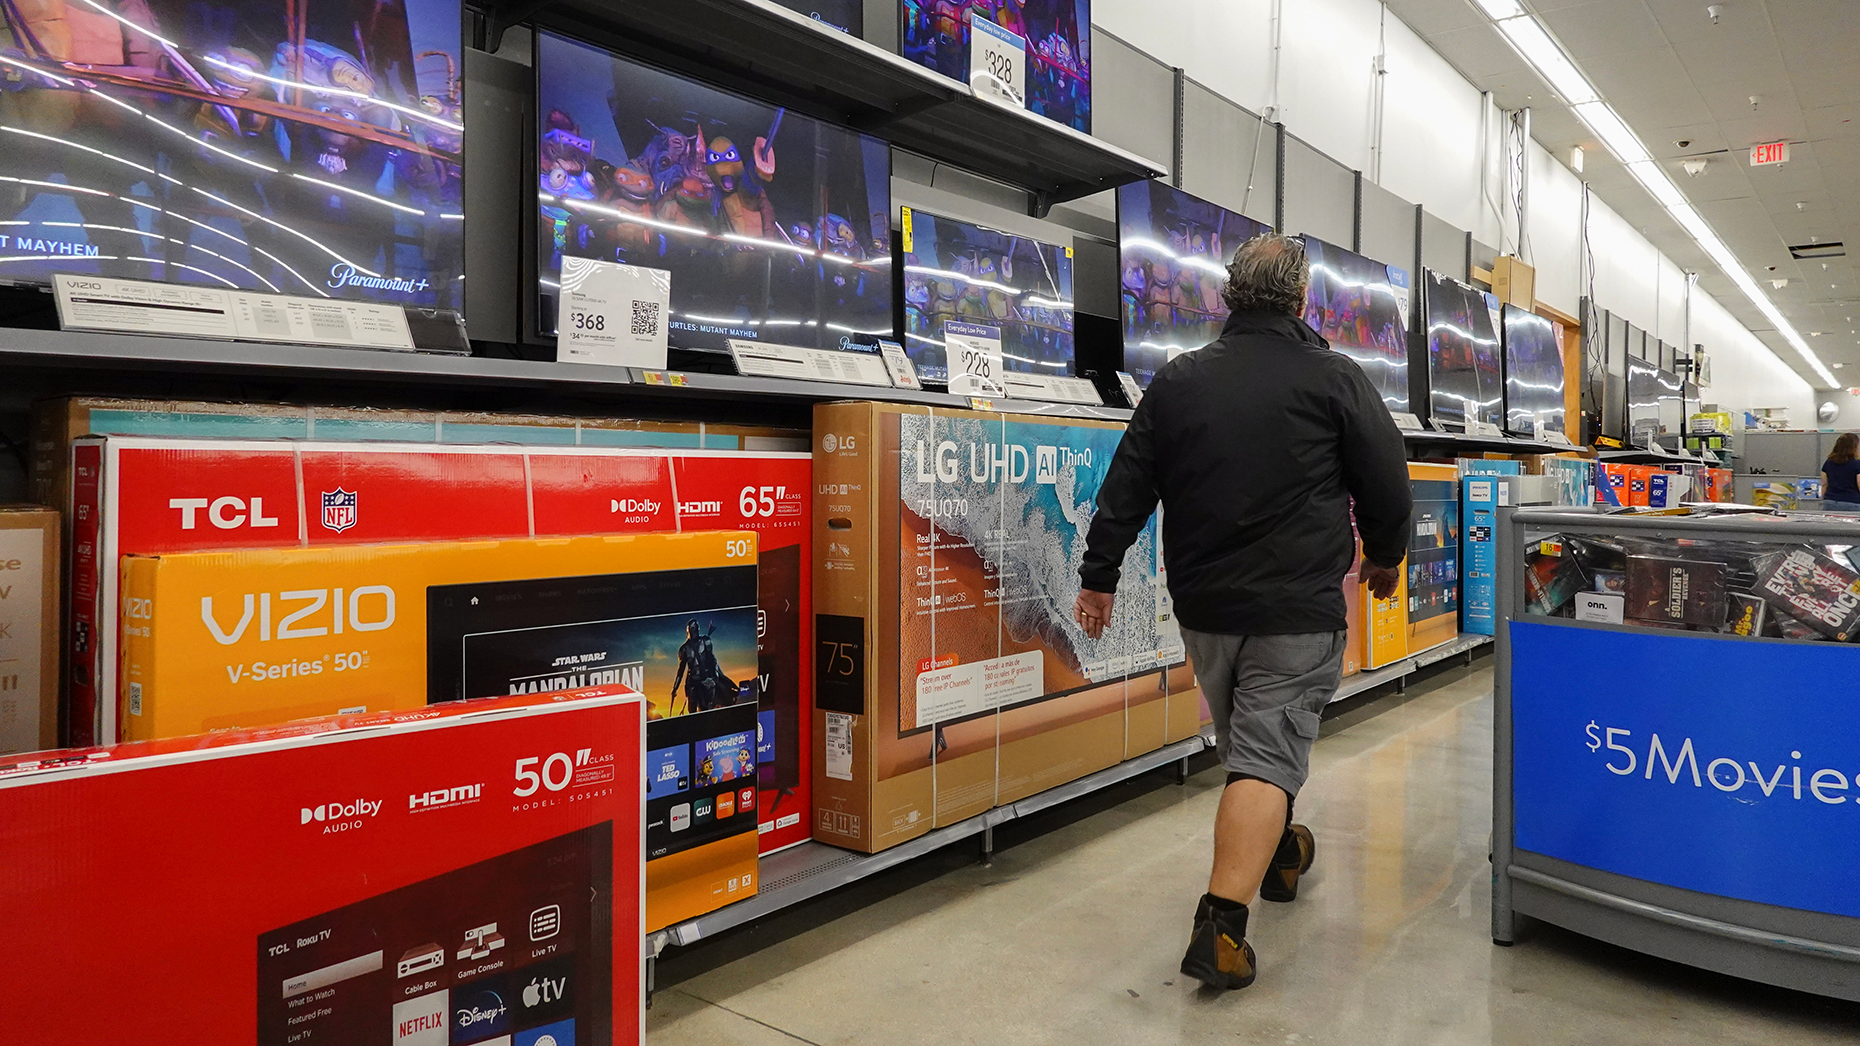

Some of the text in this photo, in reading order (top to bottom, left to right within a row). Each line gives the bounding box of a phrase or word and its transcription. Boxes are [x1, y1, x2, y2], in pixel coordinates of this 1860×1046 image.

[809, 11, 849, 34] Paramount+
[974, 18, 992, 33] Everyday
[984, 49, 1012, 84] $328
[1756, 143, 1784, 163] EXIT
[17, 237, 99, 257] MAYHEM
[327, 262, 429, 294] Paramount+
[67, 281, 102, 291] VIZIO
[570, 312, 605, 331] $368
[700, 325, 727, 337] MUTANT
[729, 327, 758, 339] MAYHEM
[948, 324, 987, 336] Everyday Low Price
[839, 336, 879, 352] Paramount+
[839, 436, 855, 450] LG
[917, 440, 958, 483] LG
[971, 443, 1029, 483] UHD
[1060, 447, 1092, 468] ThinQ
[78, 467, 88, 477] TCL
[819, 484, 838, 495] UHD
[628, 500, 661, 515] Dolby
[678, 501, 721, 514] HDMI
[739, 486, 786, 518] 65"
[169, 496, 279, 530] TCL
[326, 508, 353, 526] NFL
[625, 516, 650, 524] AUDIO
[916, 533, 930, 544] Real
[1546, 544, 1553, 552] 16
[946, 592, 966, 603] webOS
[1671, 567, 1682, 618] SOLDIER'S
[123, 598, 152, 620] VIZIO
[1587, 601, 1608, 610] onn.
[201, 584, 396, 646] VIZIO
[552, 652, 607, 667] STAR WARS
[822, 641, 858, 676] 75"
[922, 662, 930, 670] LG
[226, 660, 324, 684] V-Series
[941, 674, 952, 682] over
[575, 690, 607, 698] TCL
[513, 748, 614, 797] 50" CLASS
[576, 770, 604, 778] DIAGONALLY
[657, 770, 680, 783] LASSO
[662, 764, 676, 774] TED
[409, 783, 481, 809] HDMI
[329, 799, 383, 820] Dolby
[513, 799, 561, 812] MODEL:
[696, 805, 711, 817] CW
[323, 820, 363, 835] AUDIO
[652, 848, 667, 857] VIZIO
[268, 929, 332, 957] TCL Roku TV
[531, 944, 557, 958] Live TV
[458, 960, 504, 979] Game Console
[288, 981, 307, 991] Home
[405, 980, 437, 995] Cable Box
[541, 976, 567, 1002] tv
[288, 988, 336, 1009] What to Watch
[288, 1007, 332, 1026] Featured Free
[457, 1004, 507, 1028] Disney+
[400, 1011, 442, 1038] NETFLIX
[288, 1030, 312, 1044] Live TV
